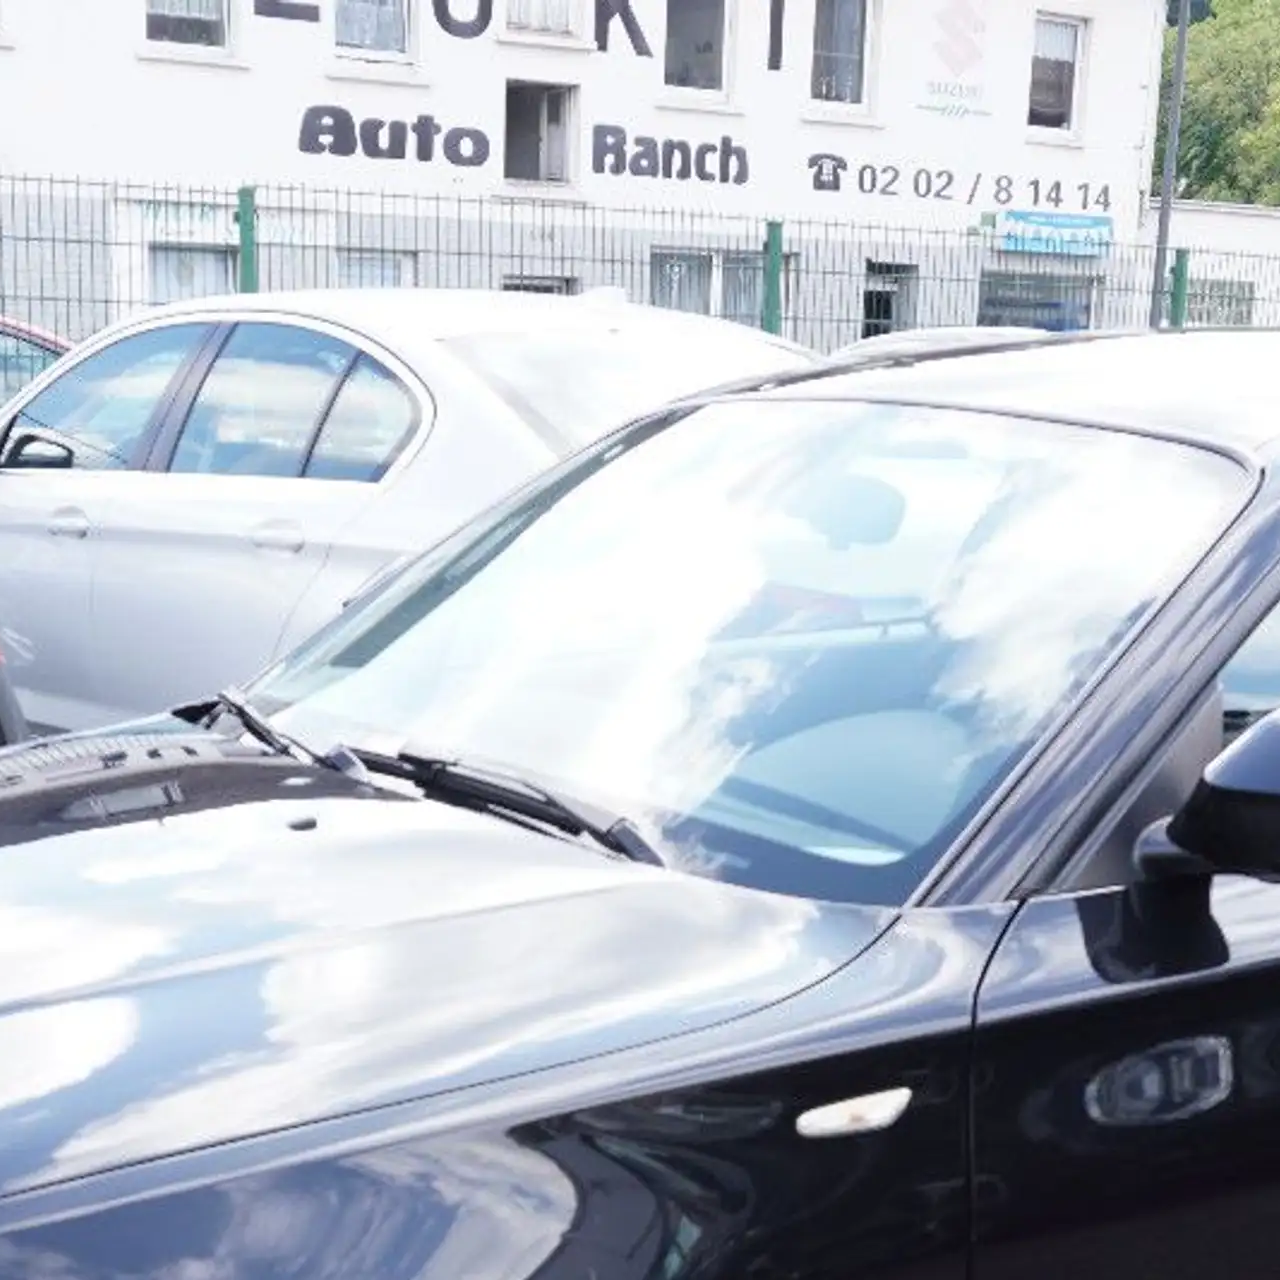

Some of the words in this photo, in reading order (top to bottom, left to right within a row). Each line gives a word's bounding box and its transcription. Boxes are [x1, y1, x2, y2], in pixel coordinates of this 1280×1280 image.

[298, 104, 491, 168] Auto
[592, 123, 750, 187] Ranch
[858, 164, 900, 197] 02
[913, 168, 955, 201] 02
[966, 172, 982, 205] /
[993, 174, 1014, 206] 8
[1028, 178, 1065, 209] 14
[1076, 181, 1112, 213] 14
